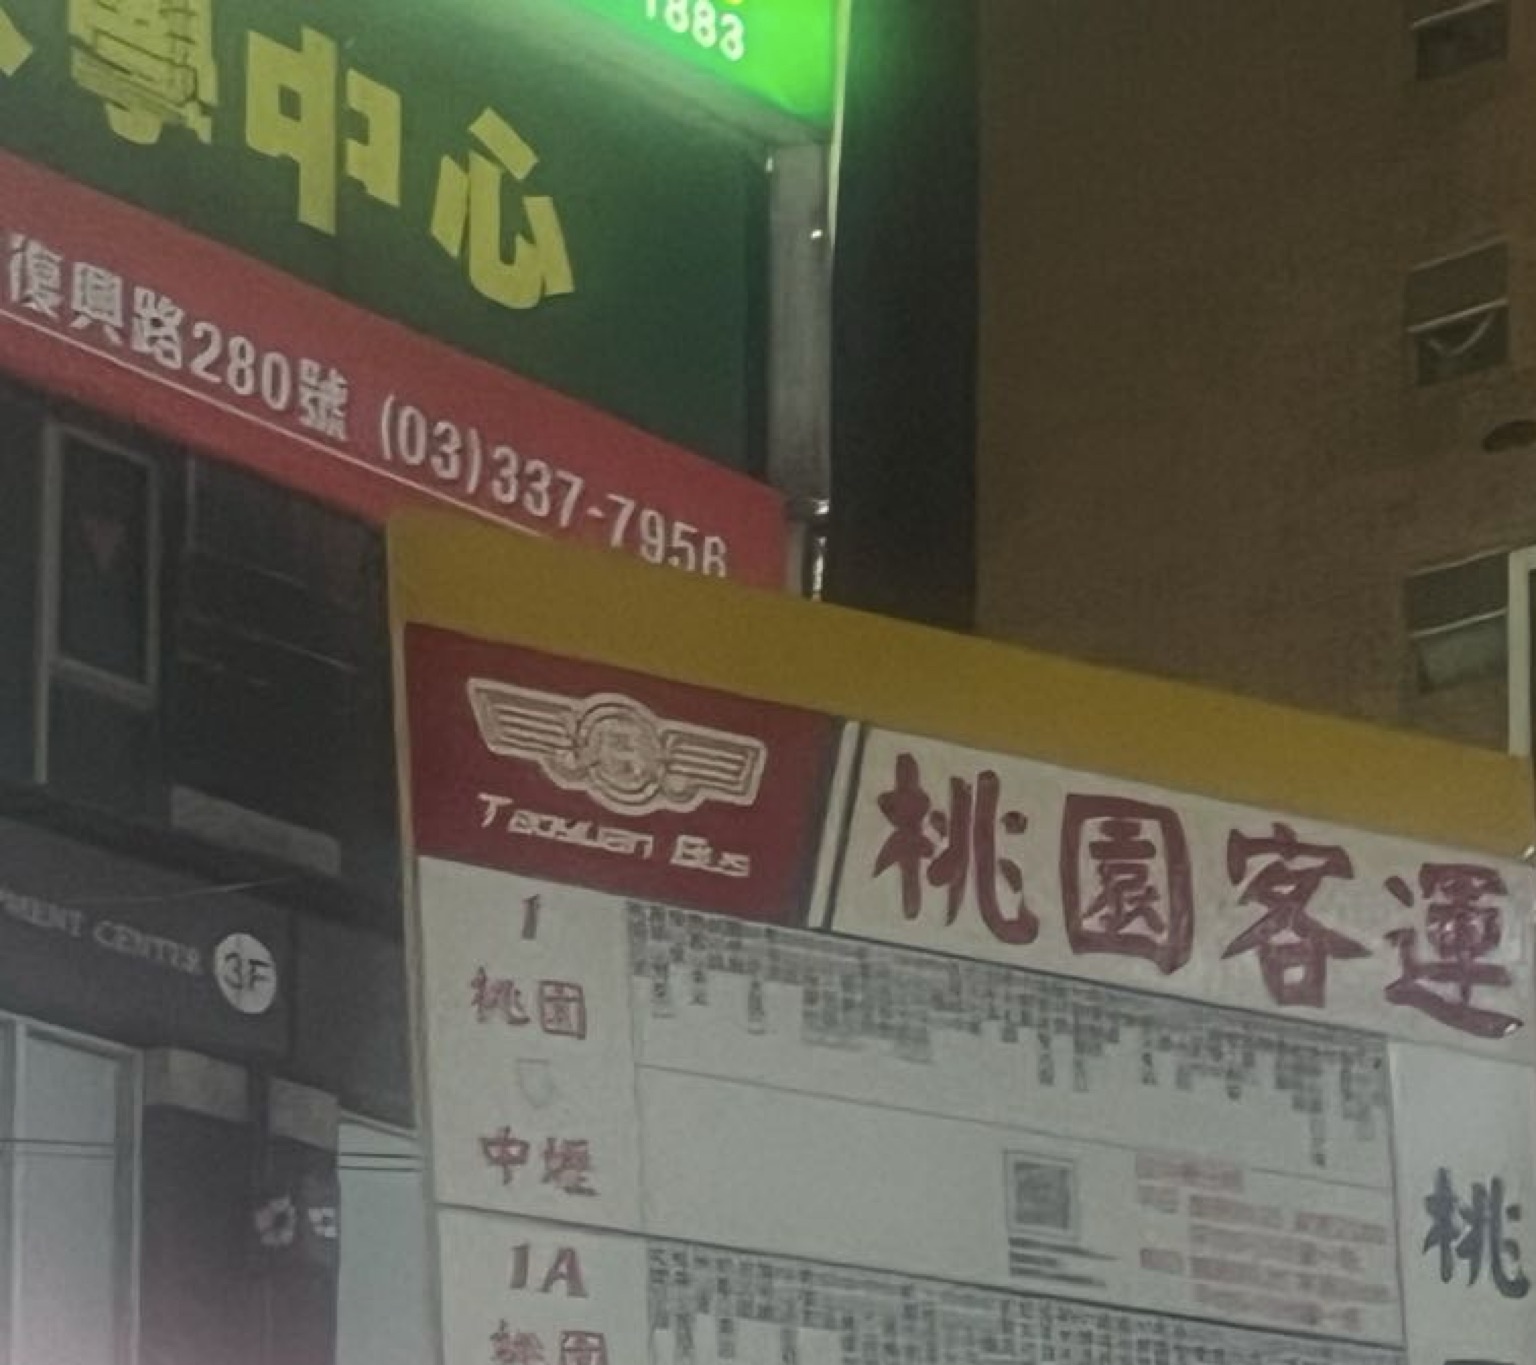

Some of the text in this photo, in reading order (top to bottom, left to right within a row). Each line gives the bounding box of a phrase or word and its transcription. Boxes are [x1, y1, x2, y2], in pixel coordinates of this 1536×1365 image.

[0, 0, 575, 310] 學中心
[8, 232, 349, 443] 復興路280號
[477, 792, 749, 877] Taoyuan Bus
[521, 894, 541, 940] 1
[873, 753, 1524, 1037] 桃園客運
[224, 952, 270, 990] 3F
[470, 965, 586, 1040] 桃園
[510, 1243, 589, 1298] 1A
